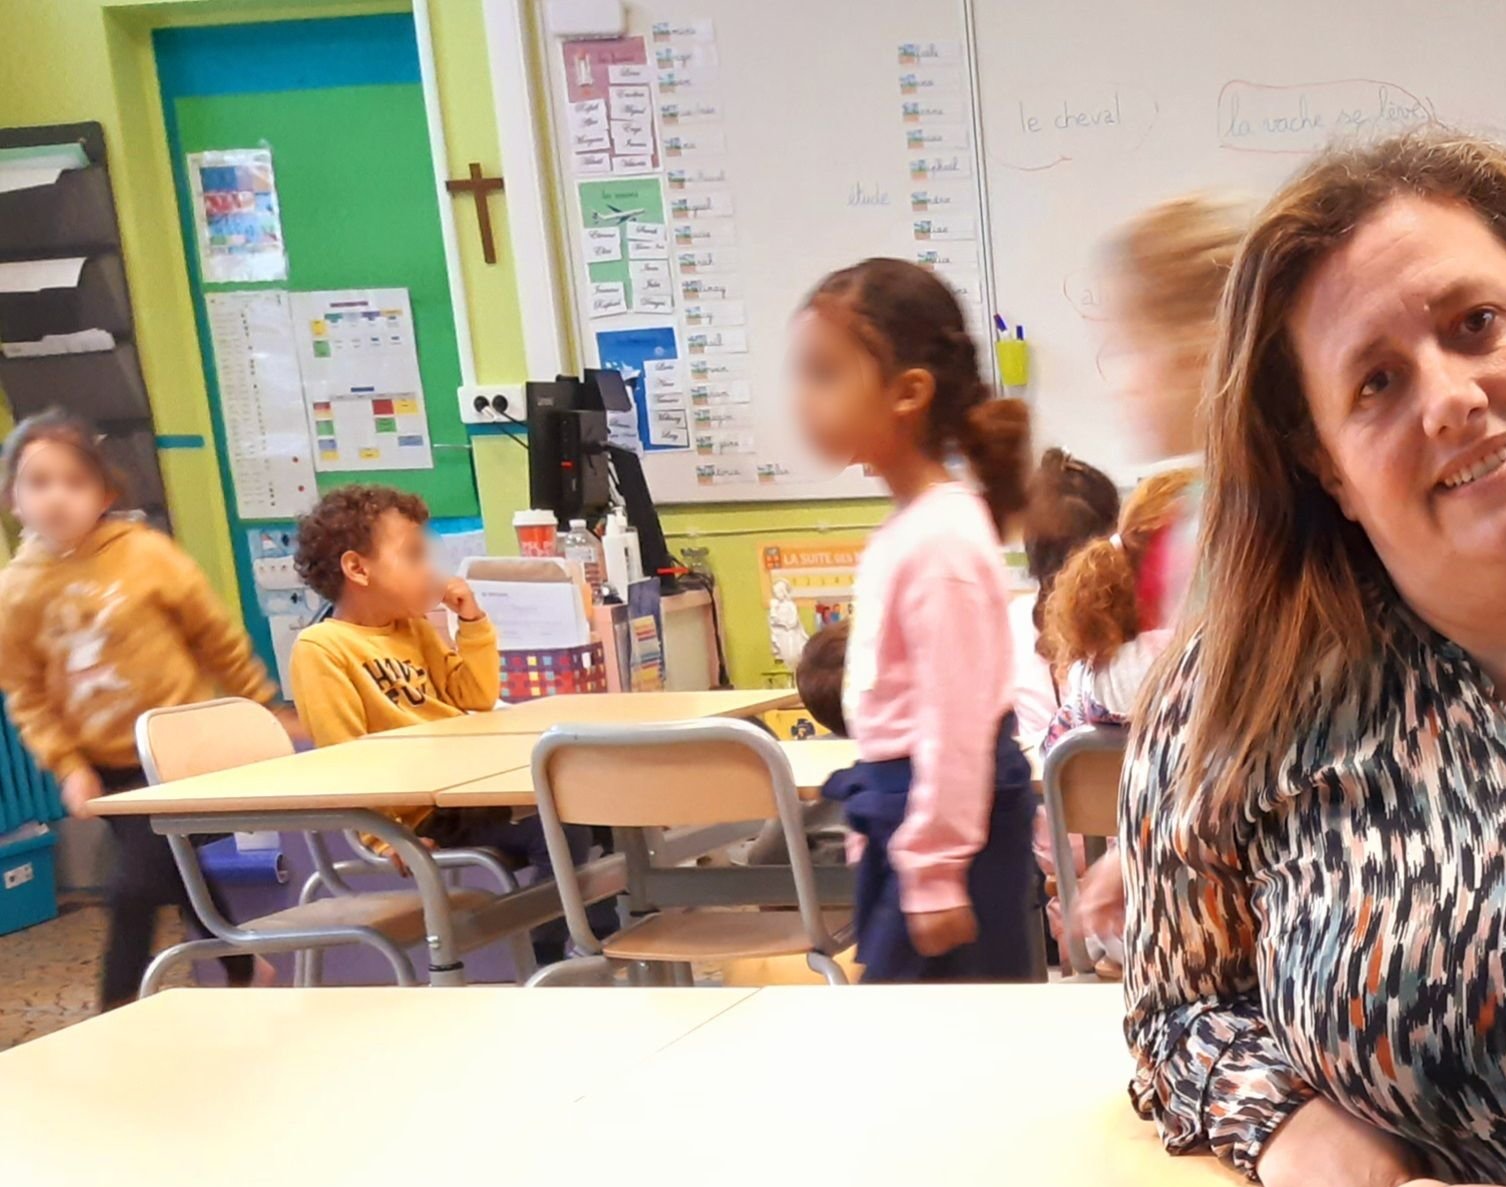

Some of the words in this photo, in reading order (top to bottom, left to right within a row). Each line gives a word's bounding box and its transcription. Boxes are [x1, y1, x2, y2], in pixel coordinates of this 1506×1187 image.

[1019, 100, 1041, 132] le
[1054, 91, 1120, 128] cheval
[1228, 93, 1250, 137] la
[1262, 97, 1322, 132] vache
[1336, 108, 1368, 132] se
[783, 553, 798, 565] LA
[800, 552, 832, 564] SUITE
